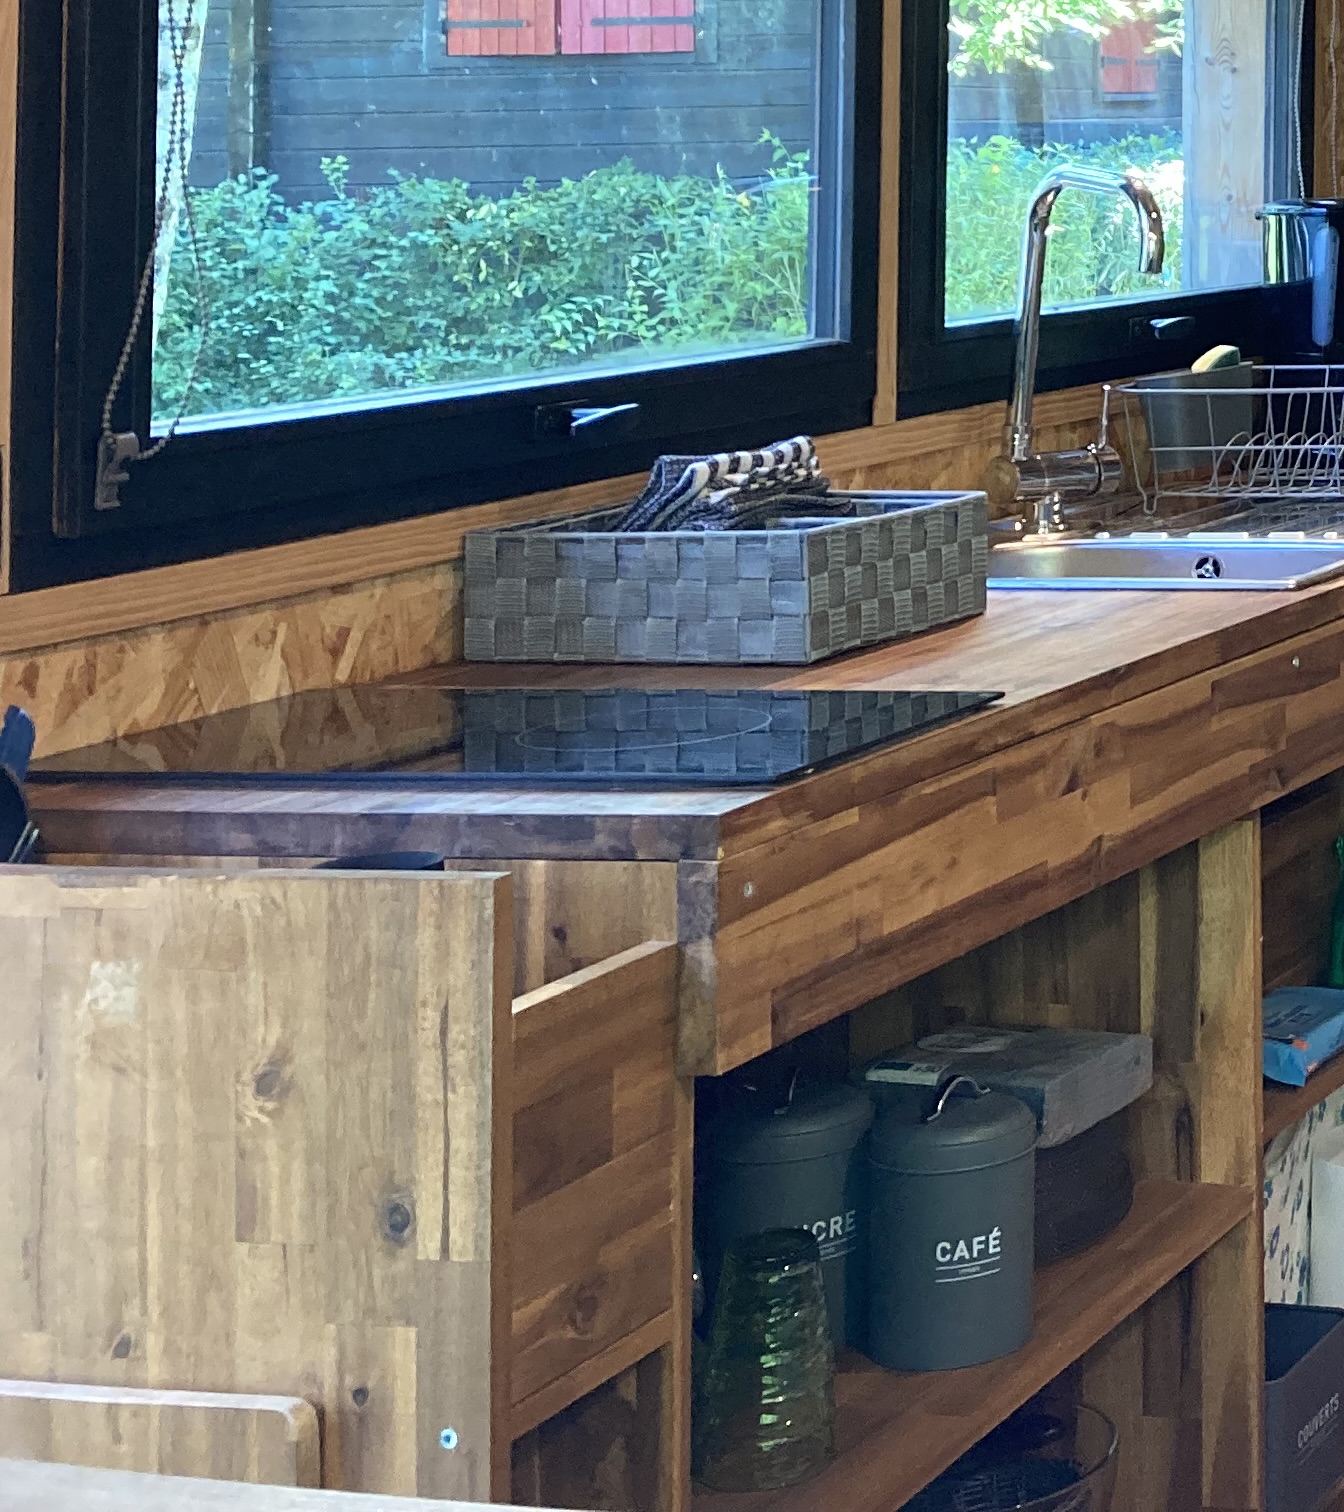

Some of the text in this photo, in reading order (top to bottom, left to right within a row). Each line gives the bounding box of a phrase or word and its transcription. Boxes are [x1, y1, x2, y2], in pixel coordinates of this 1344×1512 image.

[795, 1209, 857, 1242] CRE
[935, 1225, 1002, 1263] CAFÉ
[1297, 1392, 1340, 1449] COUVERTS
